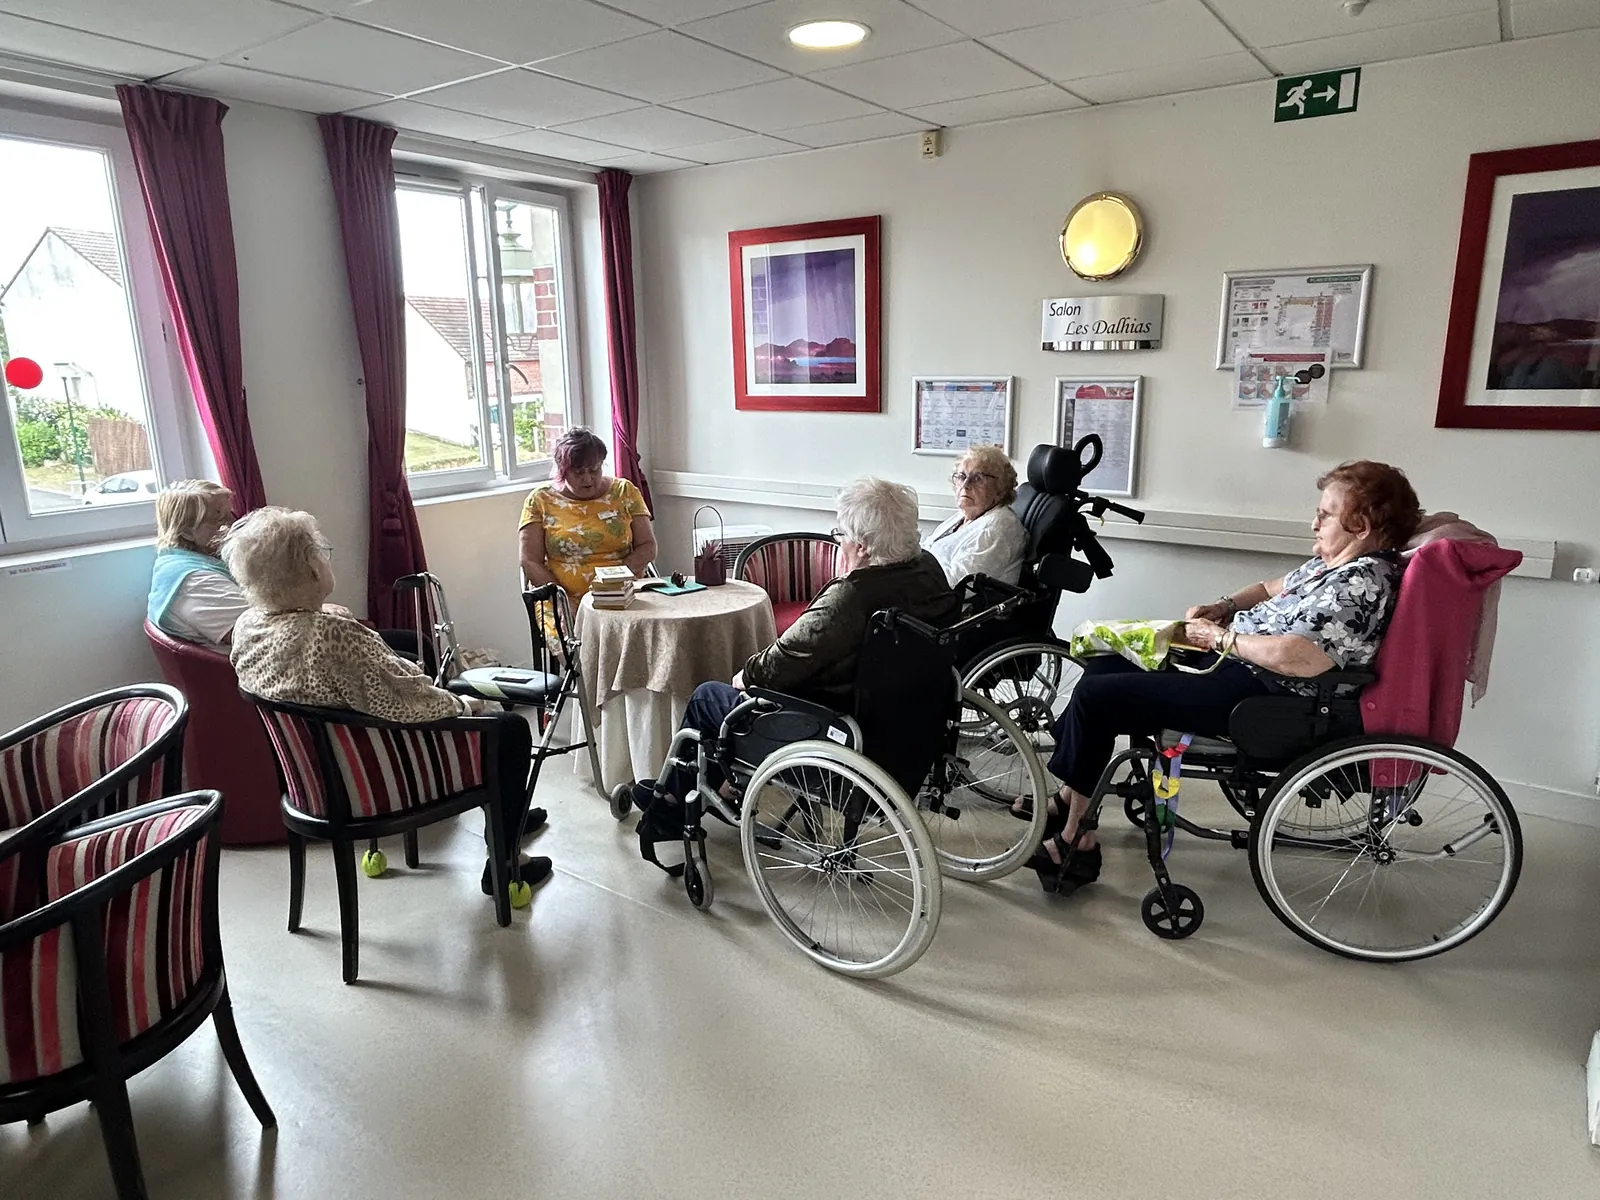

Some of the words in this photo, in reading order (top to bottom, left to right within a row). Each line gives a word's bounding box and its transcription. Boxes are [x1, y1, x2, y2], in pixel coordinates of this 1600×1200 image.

[1049, 302, 1081, 316] Salon
[1064, 321, 1089, 335] Les
[1092, 317, 1152, 335] Dalhias
